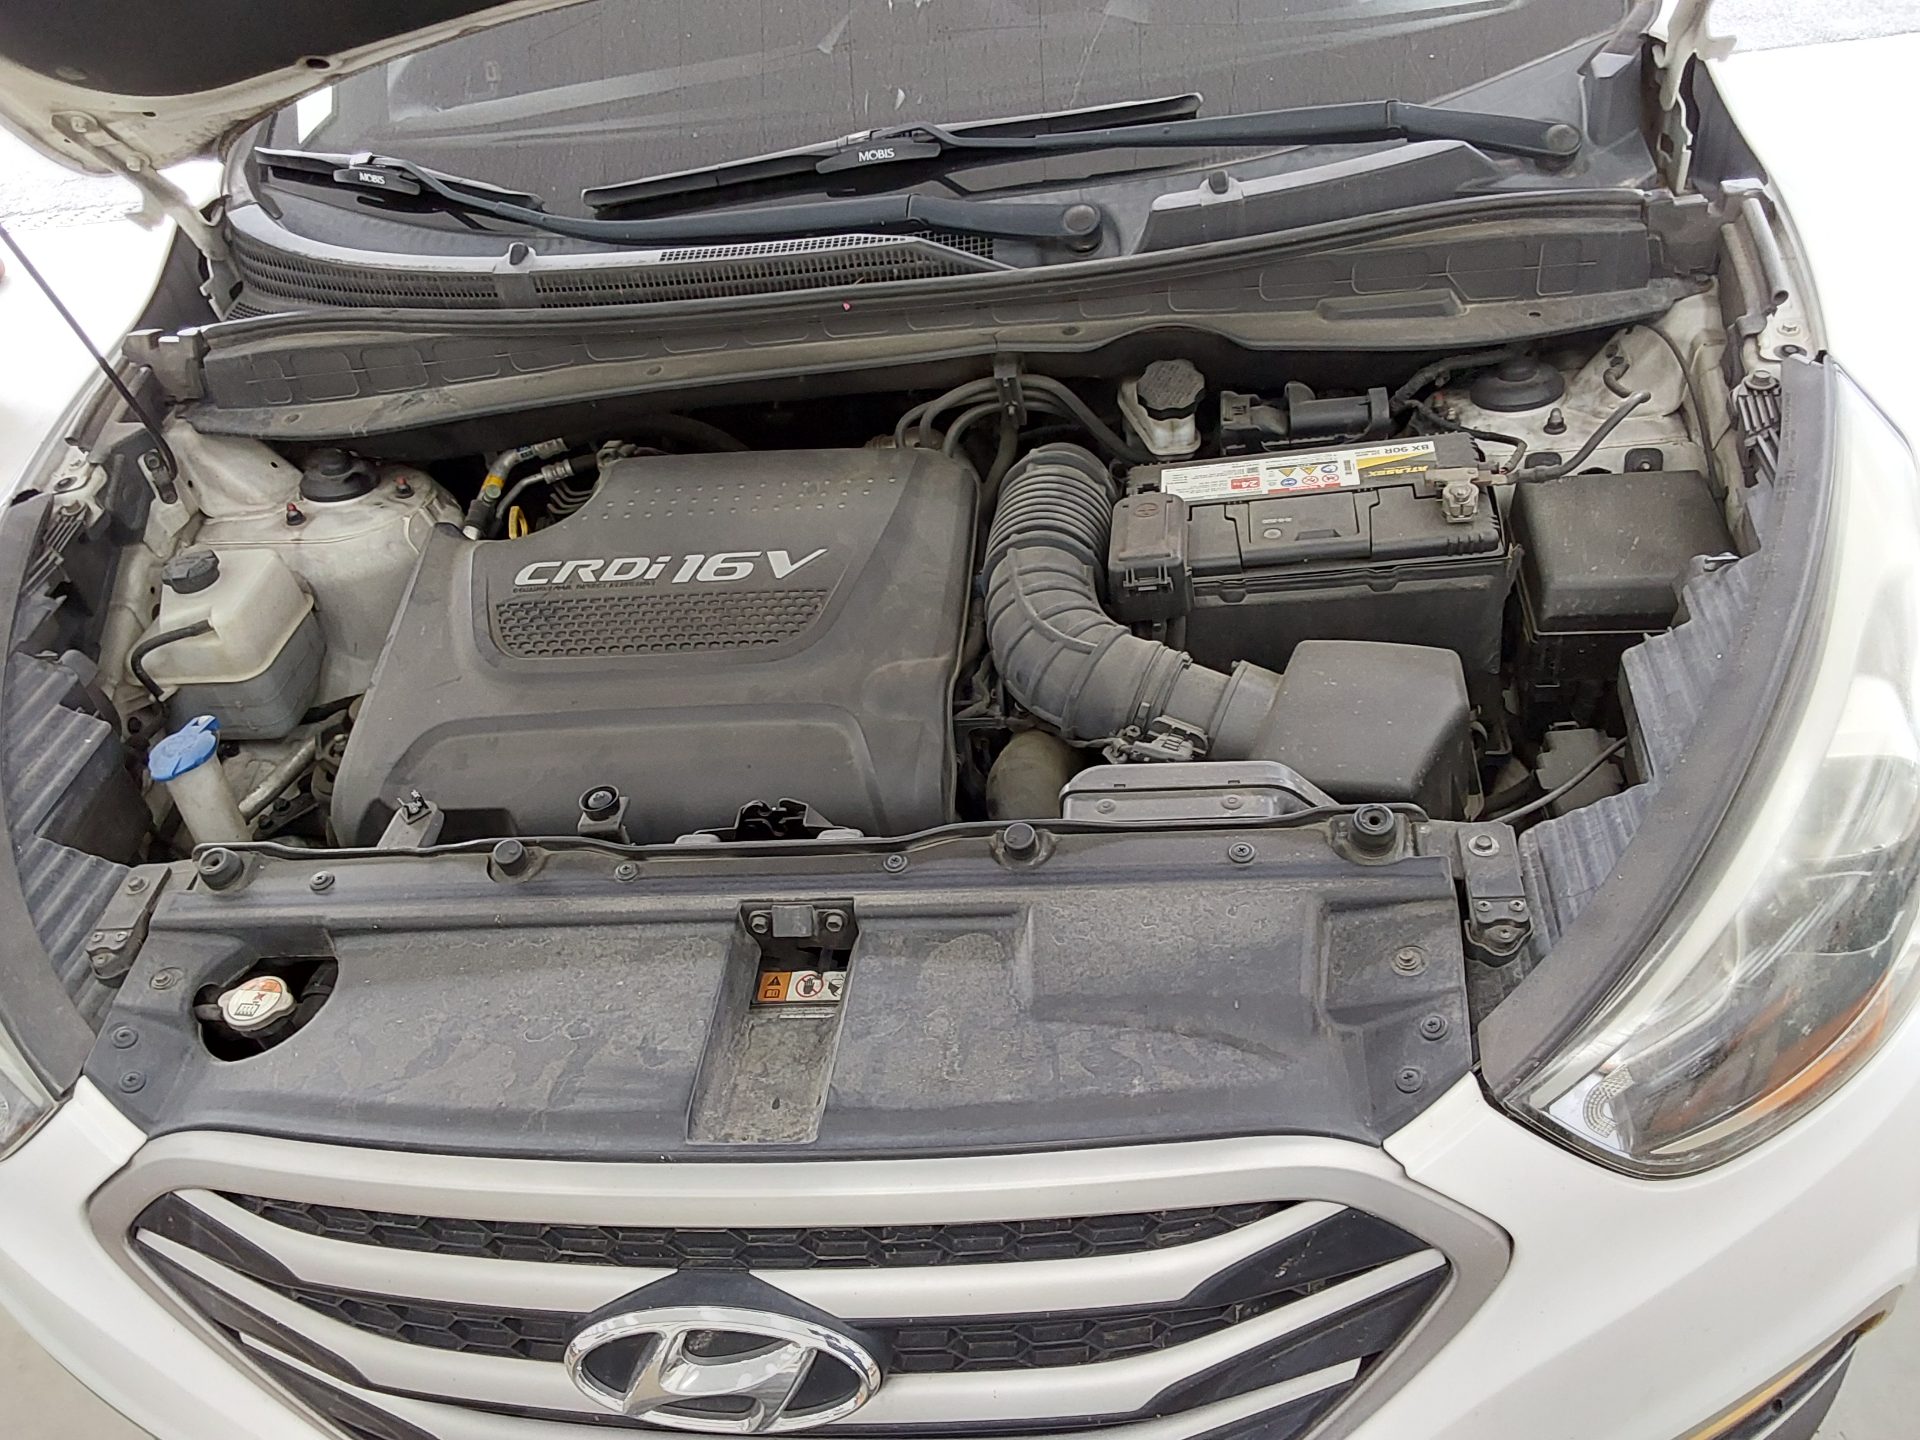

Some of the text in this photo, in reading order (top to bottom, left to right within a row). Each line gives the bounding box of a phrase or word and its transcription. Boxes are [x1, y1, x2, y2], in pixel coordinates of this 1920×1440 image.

[858, 148, 895, 162] MOBIS
[359, 170, 386, 185] MOBIS
[1384, 446, 1409, 454] 90R
[514, 555, 673, 587] CRDi
